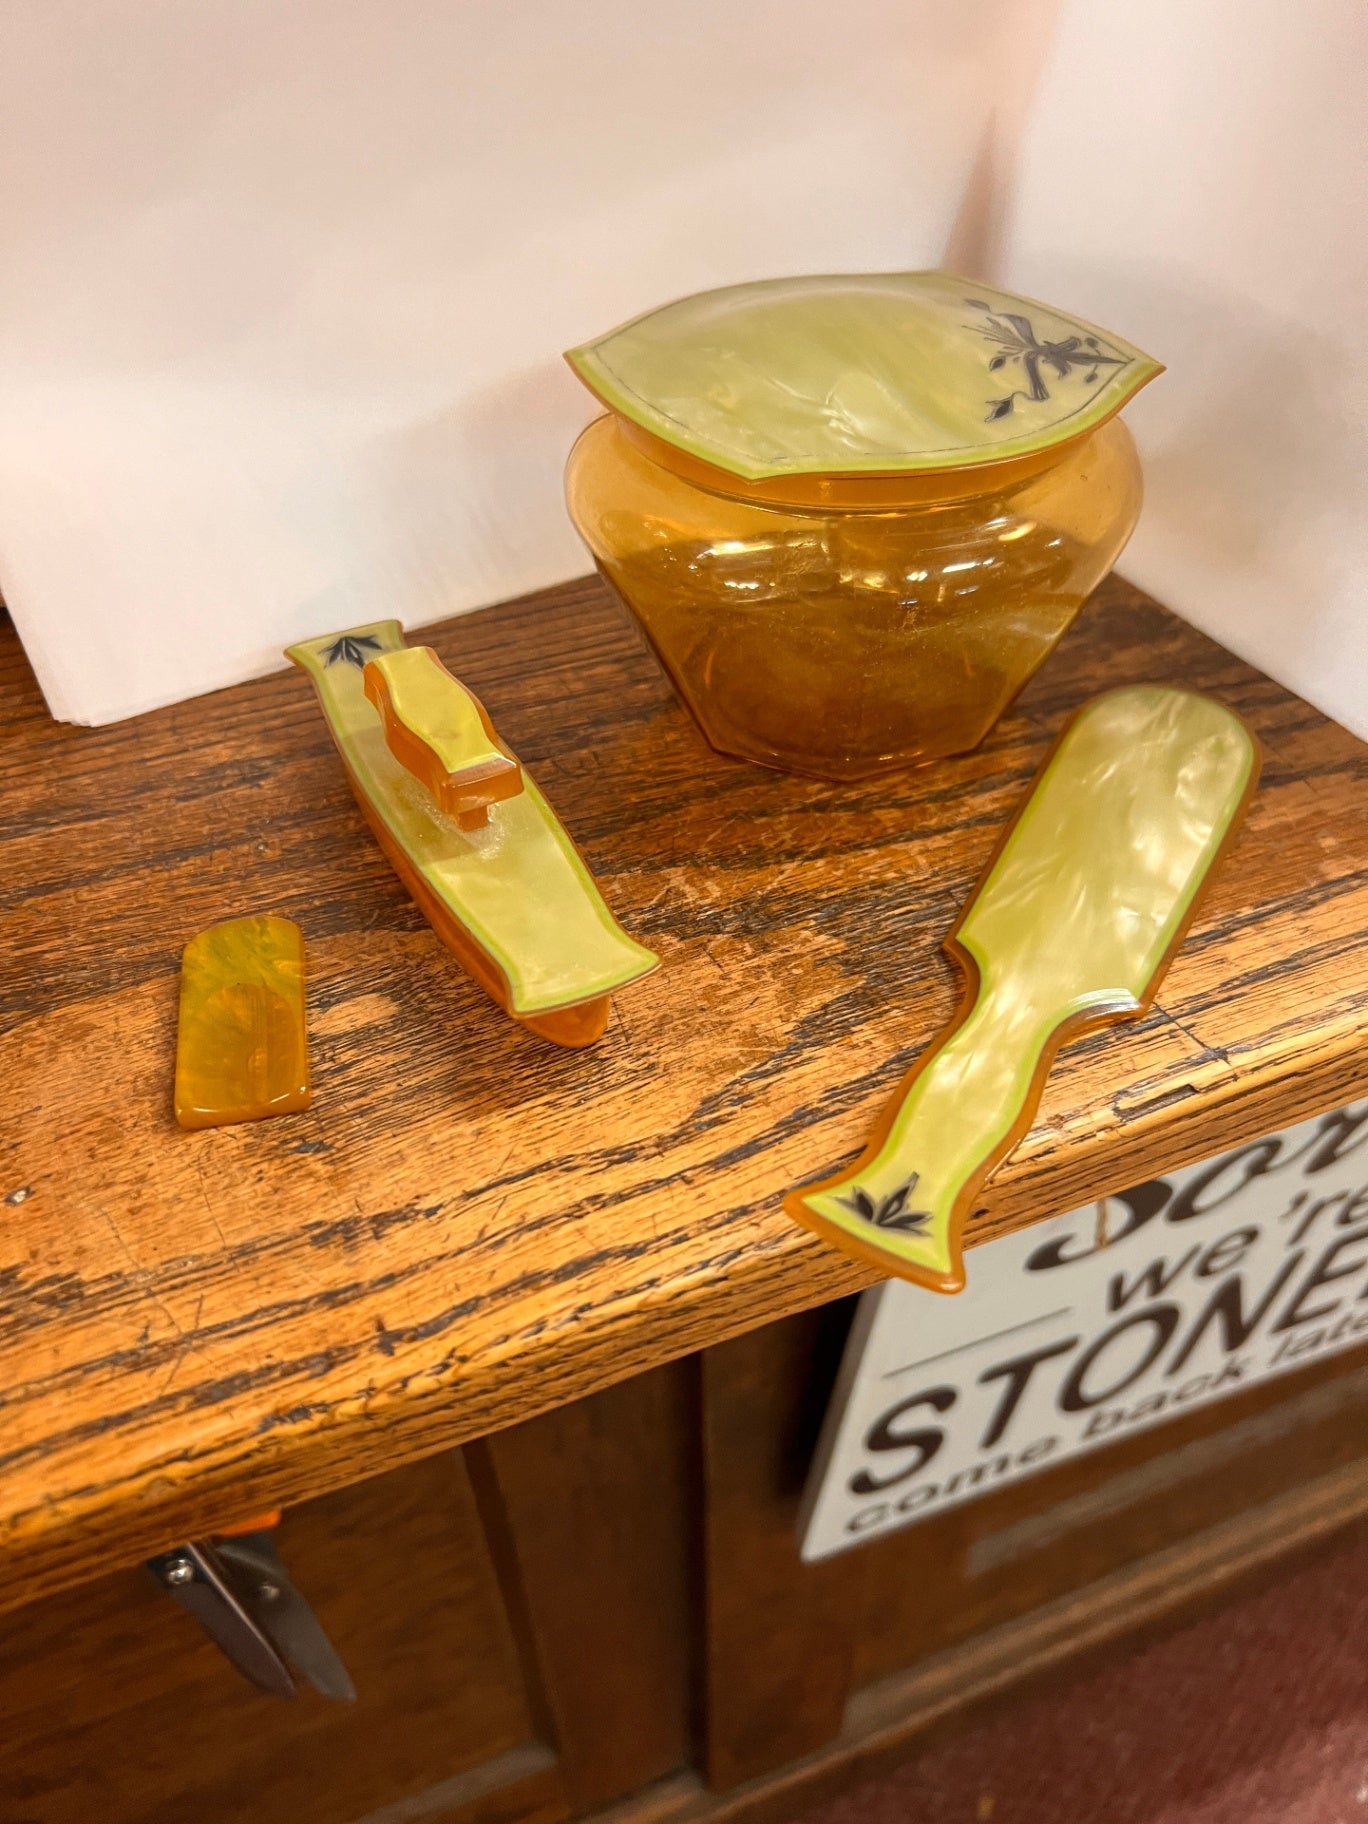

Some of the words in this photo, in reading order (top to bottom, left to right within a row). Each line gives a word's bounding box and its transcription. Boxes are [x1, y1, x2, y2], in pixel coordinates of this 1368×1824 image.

[846, 1436, 1057, 1532] come
[1083, 1356, 1244, 1440] back
[850, 1225, 1368, 1495] STONE
